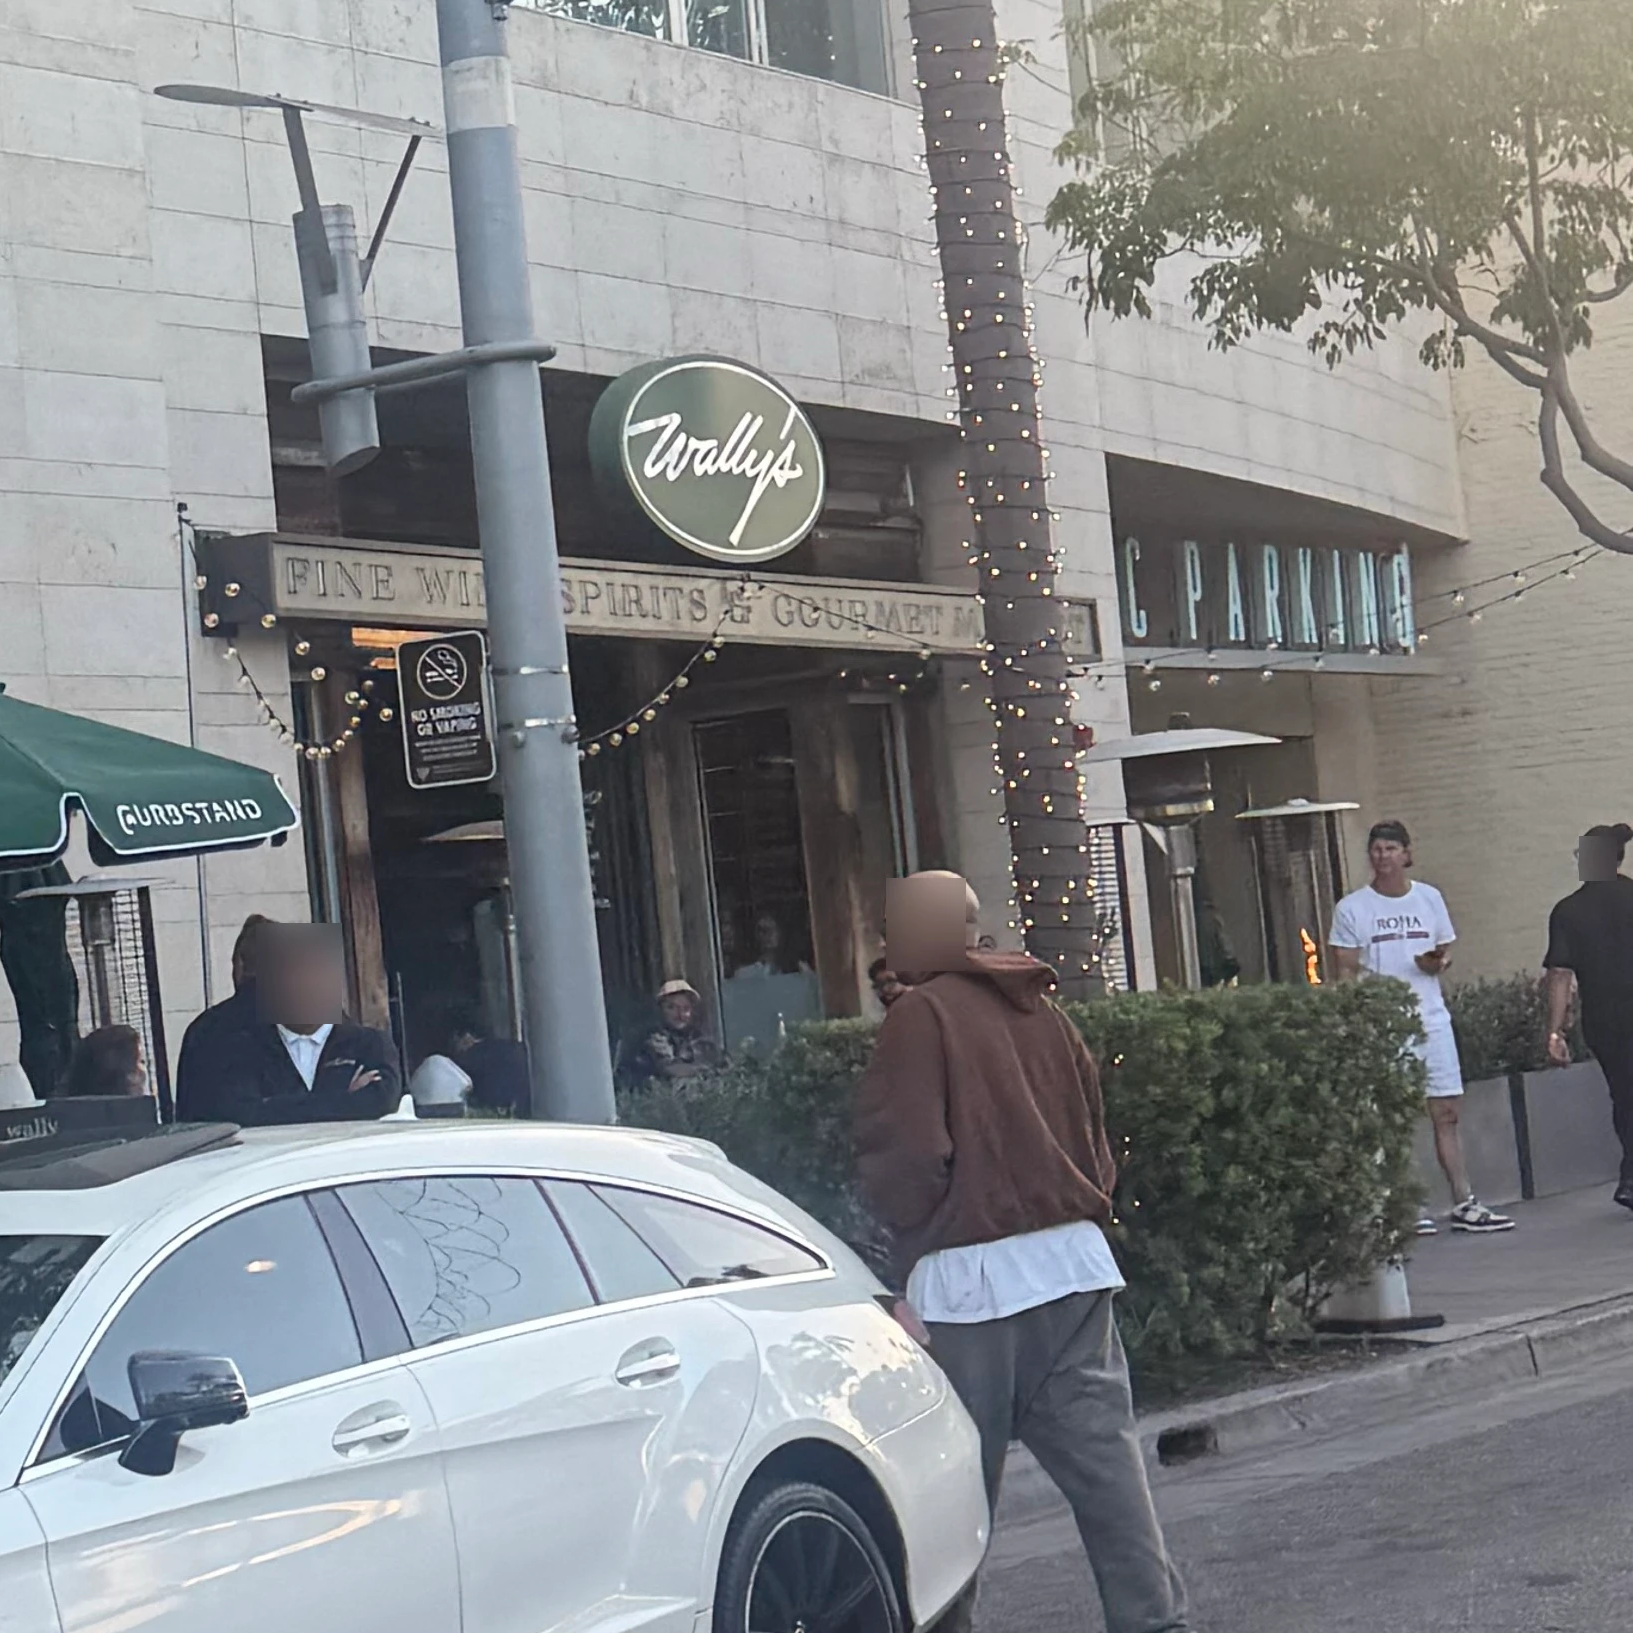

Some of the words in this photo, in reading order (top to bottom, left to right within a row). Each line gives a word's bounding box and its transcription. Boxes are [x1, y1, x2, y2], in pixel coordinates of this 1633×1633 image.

[626, 406, 804, 548] Wally's
[285, 556, 396, 601] FINE
[770, 593, 944, 636] GOURMET
[1183, 540, 1416, 656] PARKING
[410, 708, 428, 724] NO
[417, 721, 434, 737] OR
[435, 716, 478, 735] VAPING
